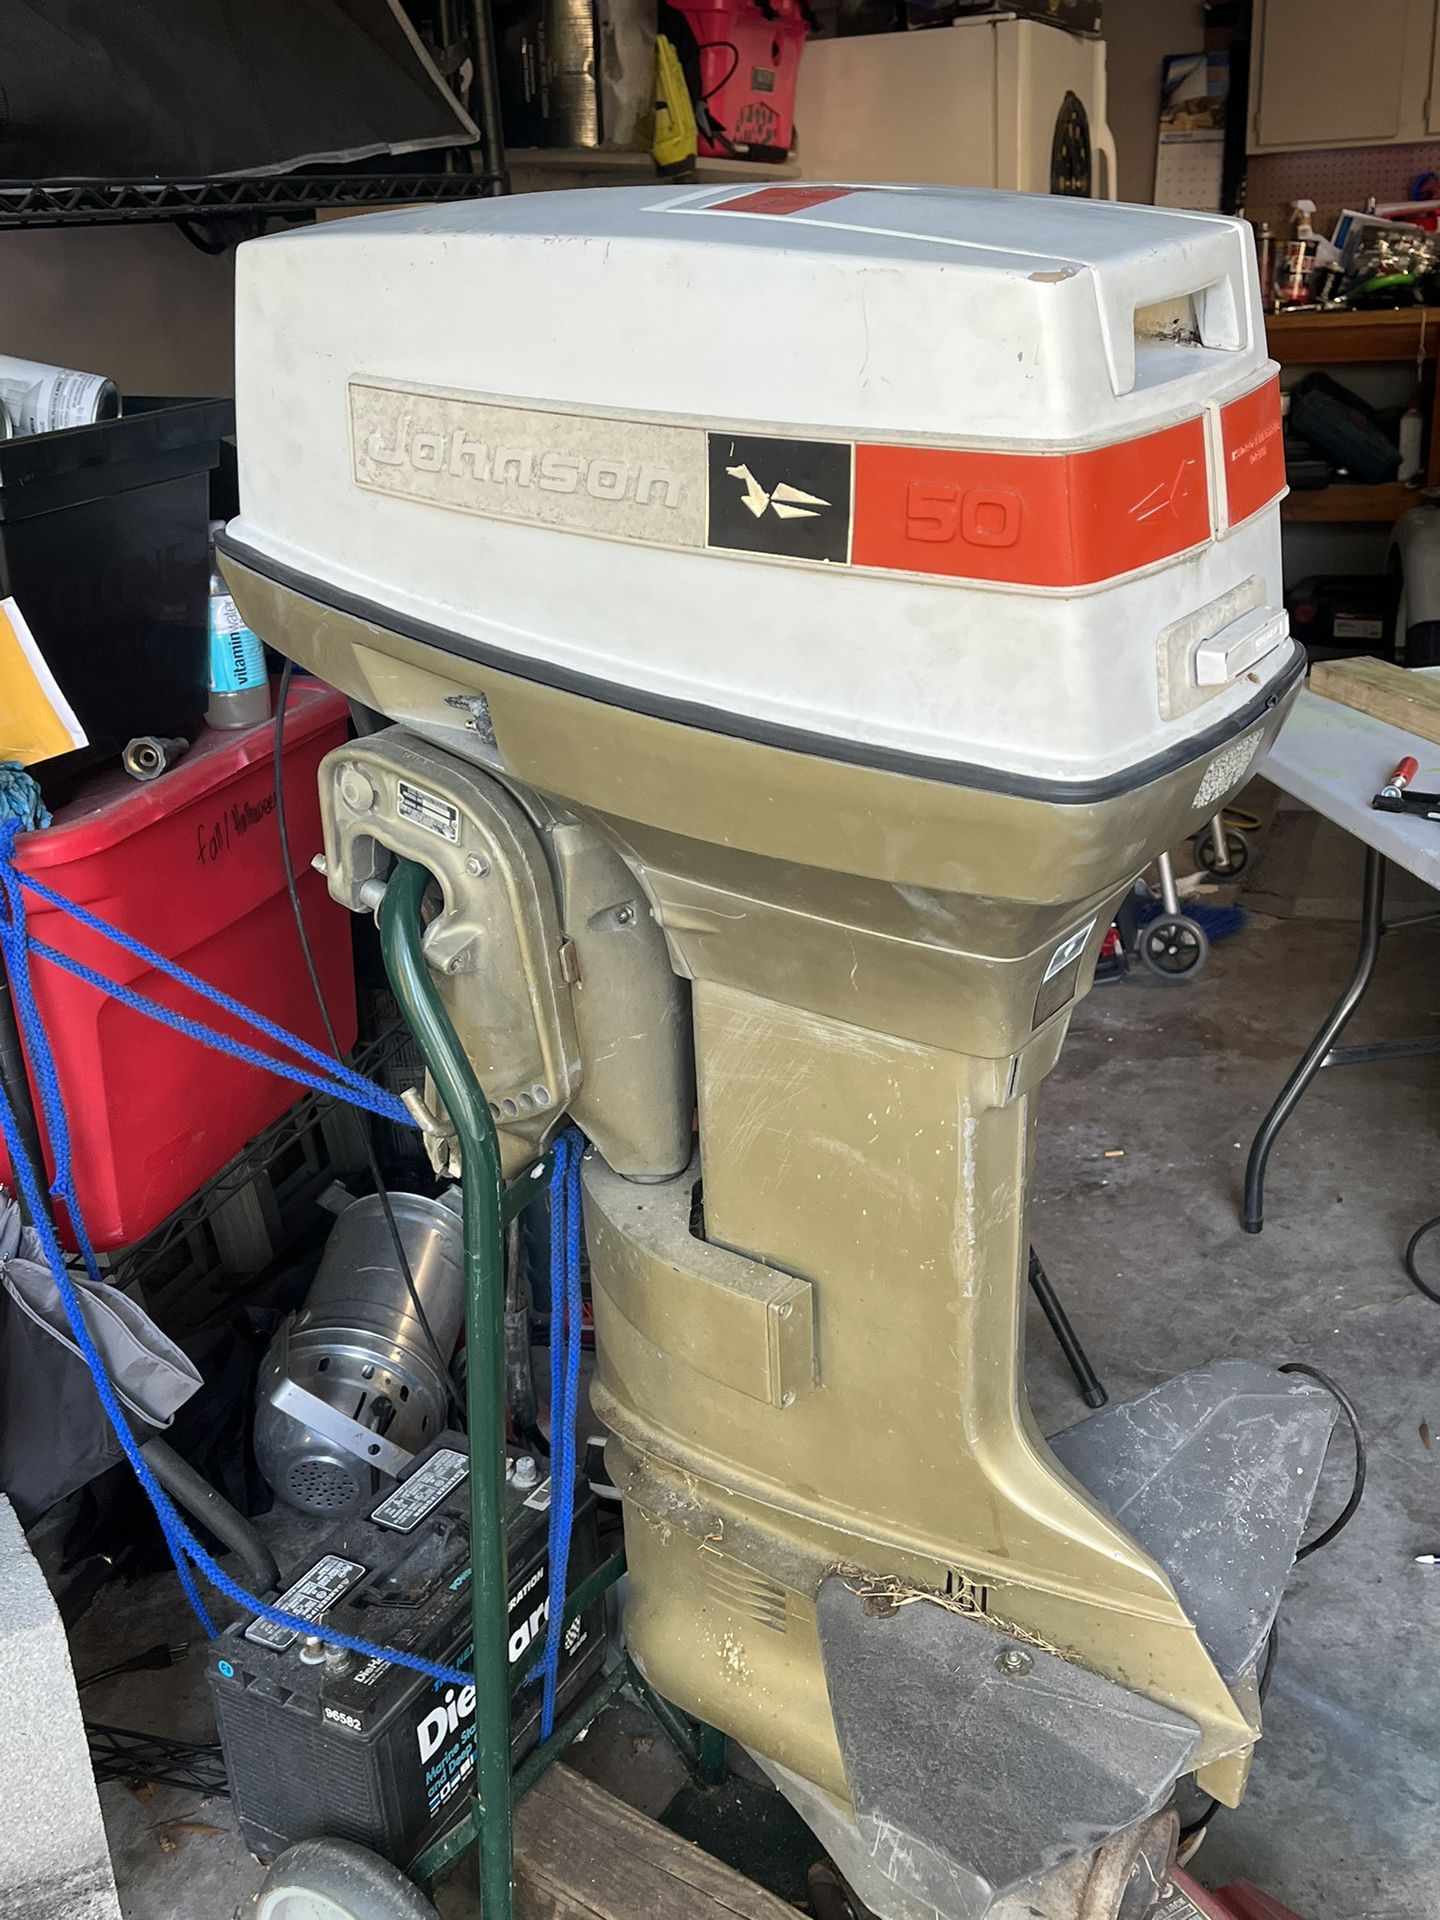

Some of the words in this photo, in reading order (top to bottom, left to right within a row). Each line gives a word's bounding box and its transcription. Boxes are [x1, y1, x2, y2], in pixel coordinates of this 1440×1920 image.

[367, 415, 682, 509] Johnson
[905, 481, 1024, 549] 50
[224, 600, 248, 685] vitaminwater
[508, 1567, 544, 1614] RATION
[353, 1655, 386, 1684] DieH
[324, 1707, 362, 1731] 96582
[424, 1743, 460, 1786] Marine
[427, 1771, 447, 1798] and
[448, 1743, 473, 1774] Deep
[1165, 1897, 1188, 1913] JACK
